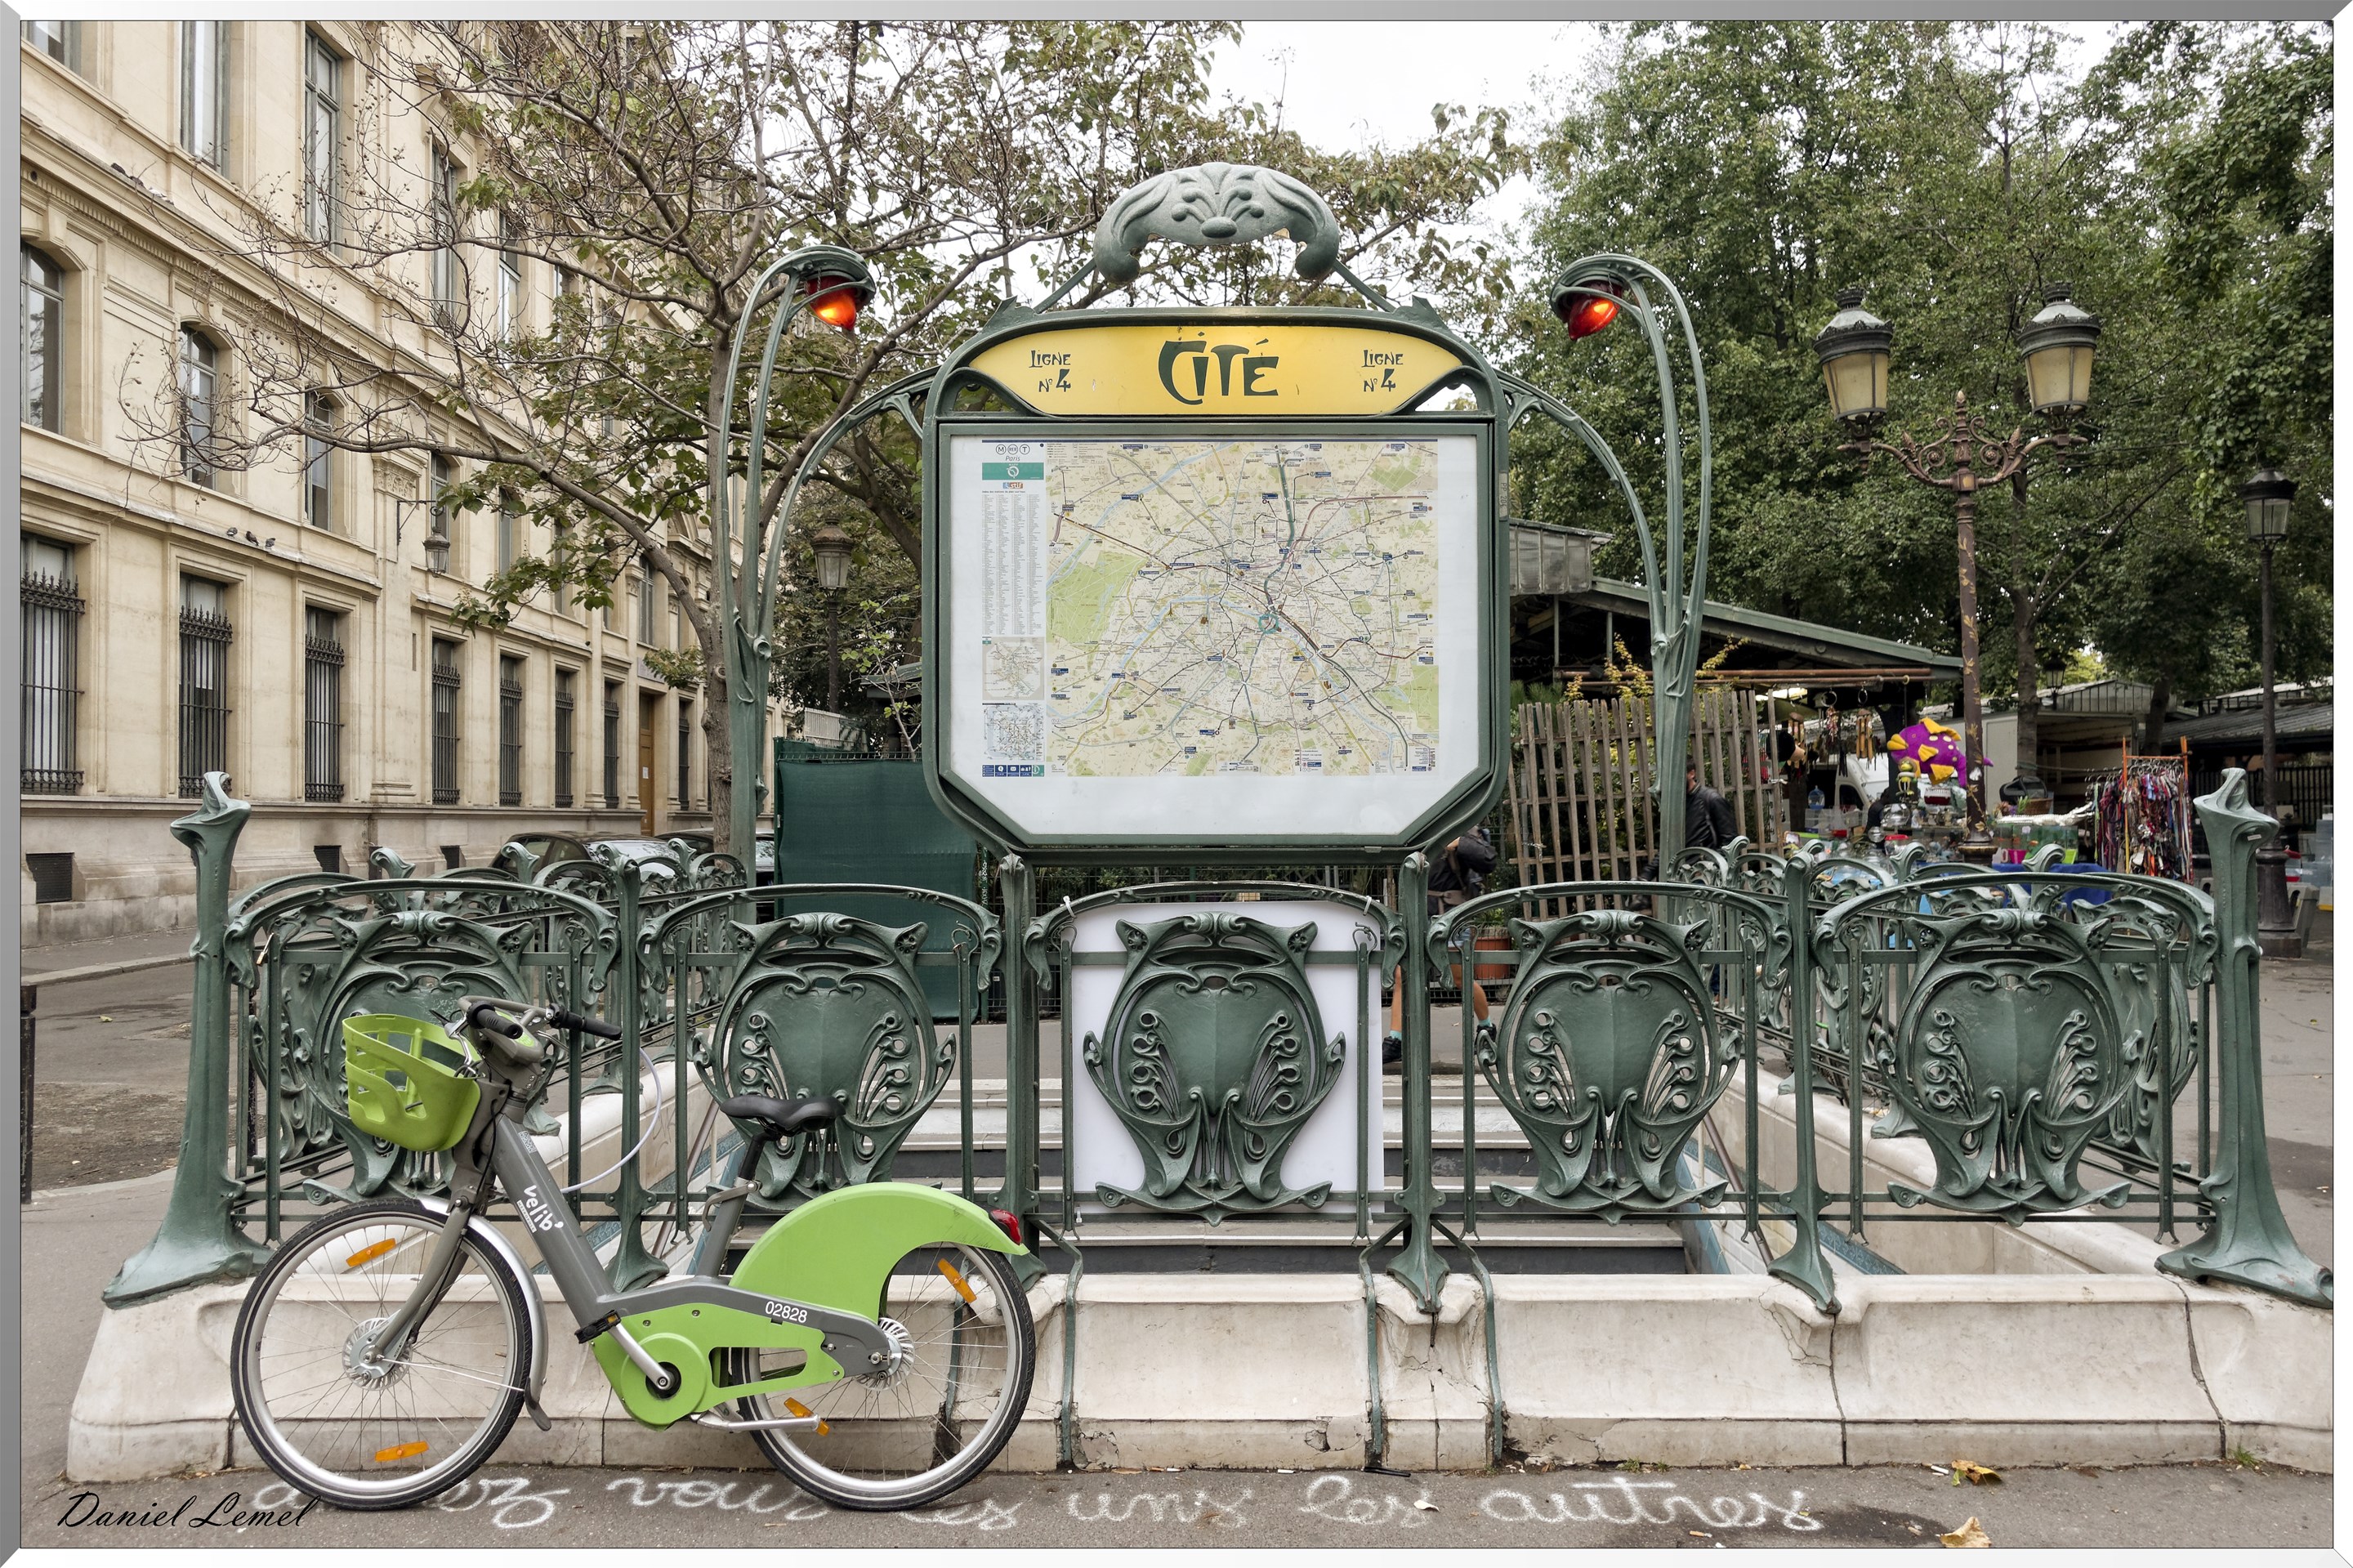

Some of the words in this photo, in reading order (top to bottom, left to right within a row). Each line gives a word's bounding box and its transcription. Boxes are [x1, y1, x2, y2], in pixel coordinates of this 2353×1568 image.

[1056, 369, 1072, 392] 4
[1381, 368, 1396, 392] 4
[765, 1301, 808, 1324] 02828
[1480, 1477, 1824, 1531] autres
